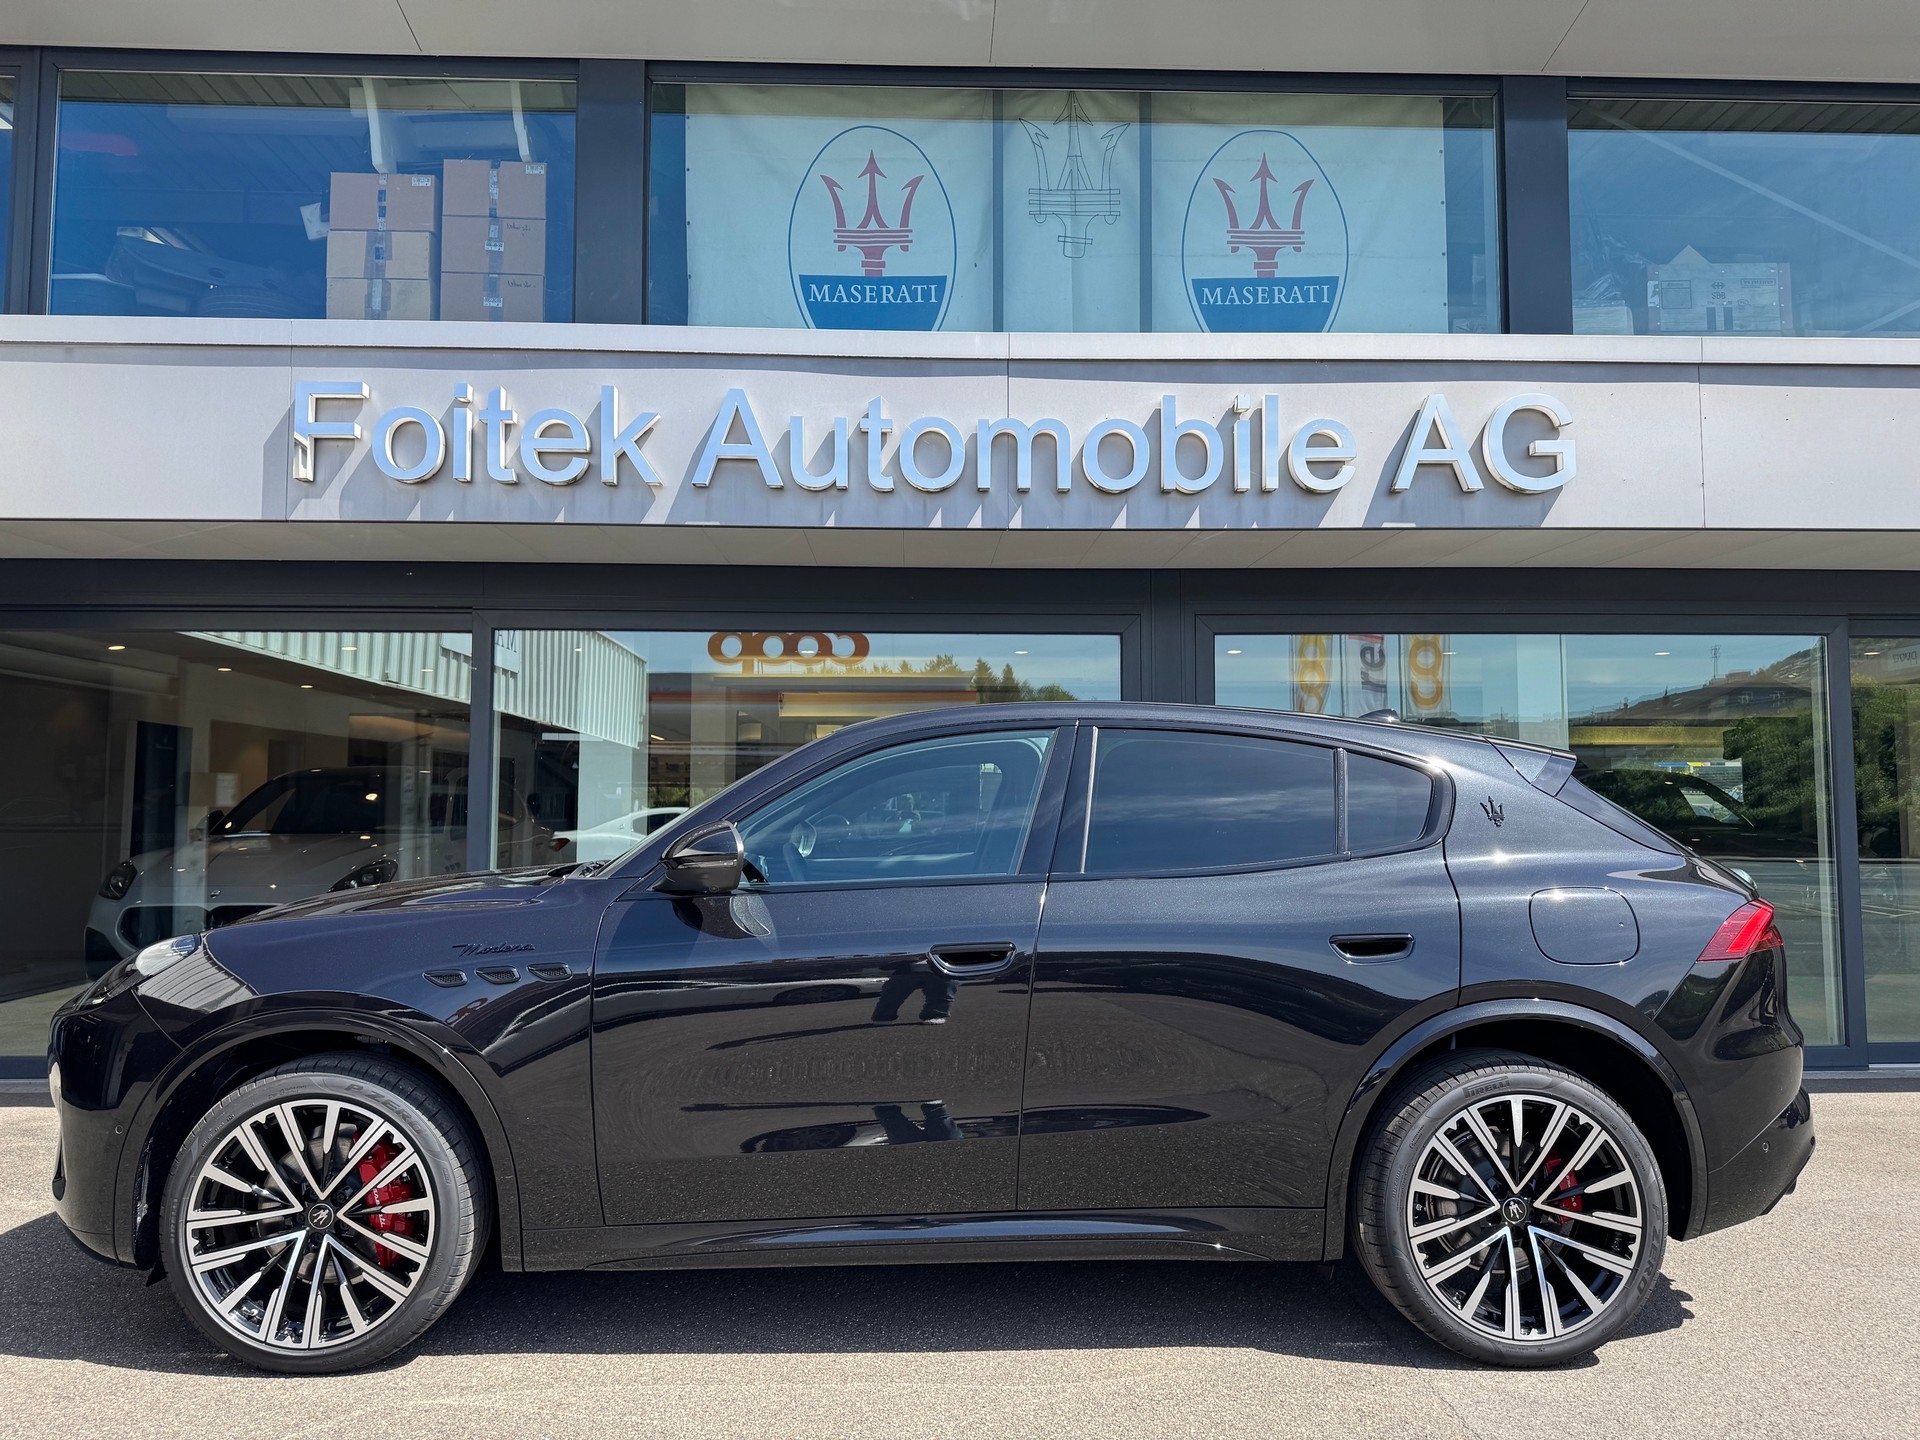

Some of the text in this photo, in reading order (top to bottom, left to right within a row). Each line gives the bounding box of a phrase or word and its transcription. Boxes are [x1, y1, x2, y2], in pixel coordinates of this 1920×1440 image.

[808, 283, 938, 304] MASERATI
[1201, 285, 1330, 305] MASERATI
[293, 381, 1578, 494] Foitek Automobile AG
[1462, 1075, 1510, 1099] PIRELLI
[365, 1090, 424, 1134] ZERO
